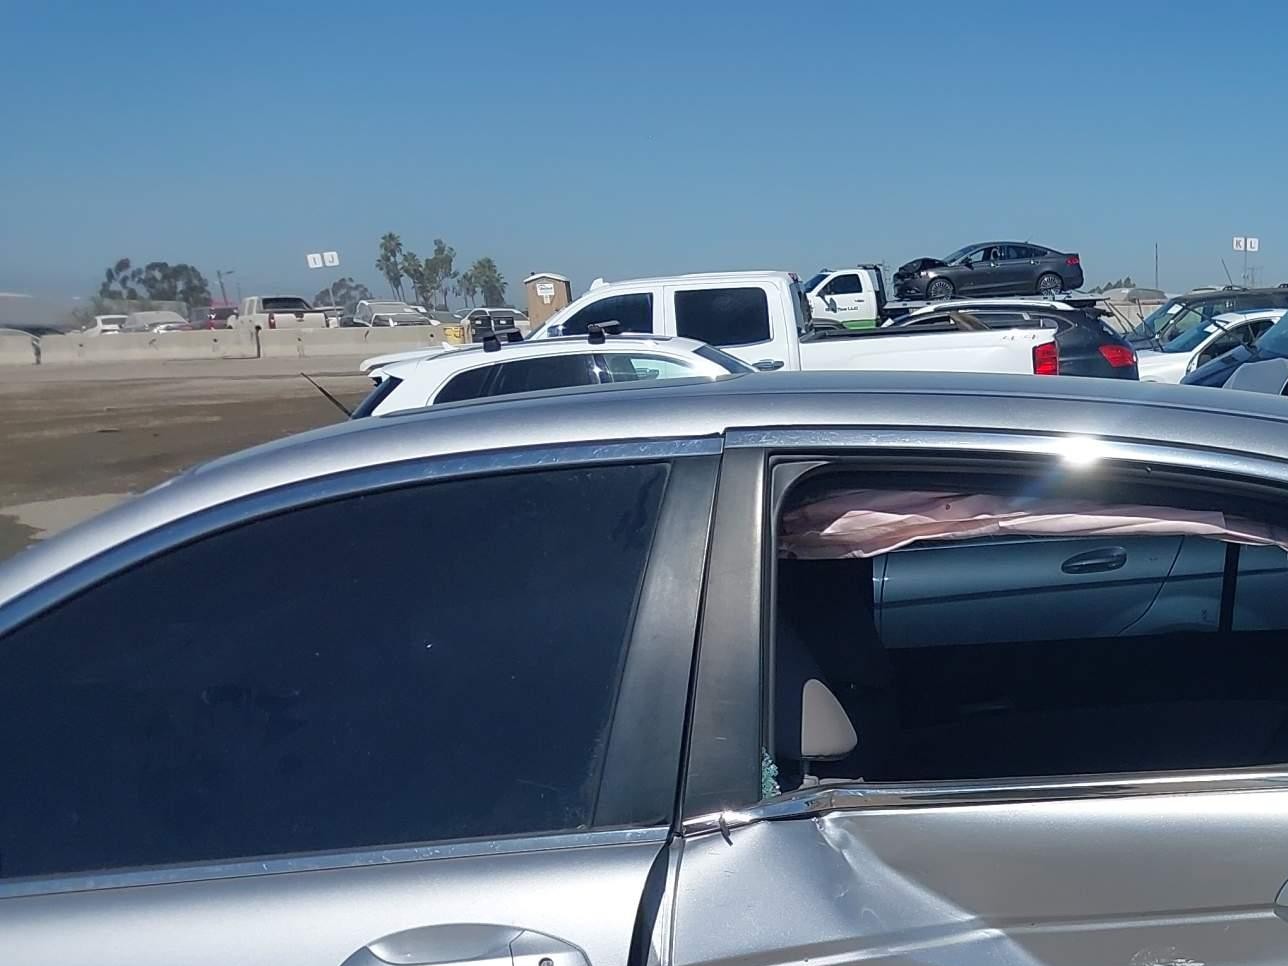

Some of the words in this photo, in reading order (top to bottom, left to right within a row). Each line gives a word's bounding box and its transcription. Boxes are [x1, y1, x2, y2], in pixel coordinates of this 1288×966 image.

[1235, 239, 1242, 249] K
[1249, 239, 1255, 249] L
[328, 255, 335, 264] J
